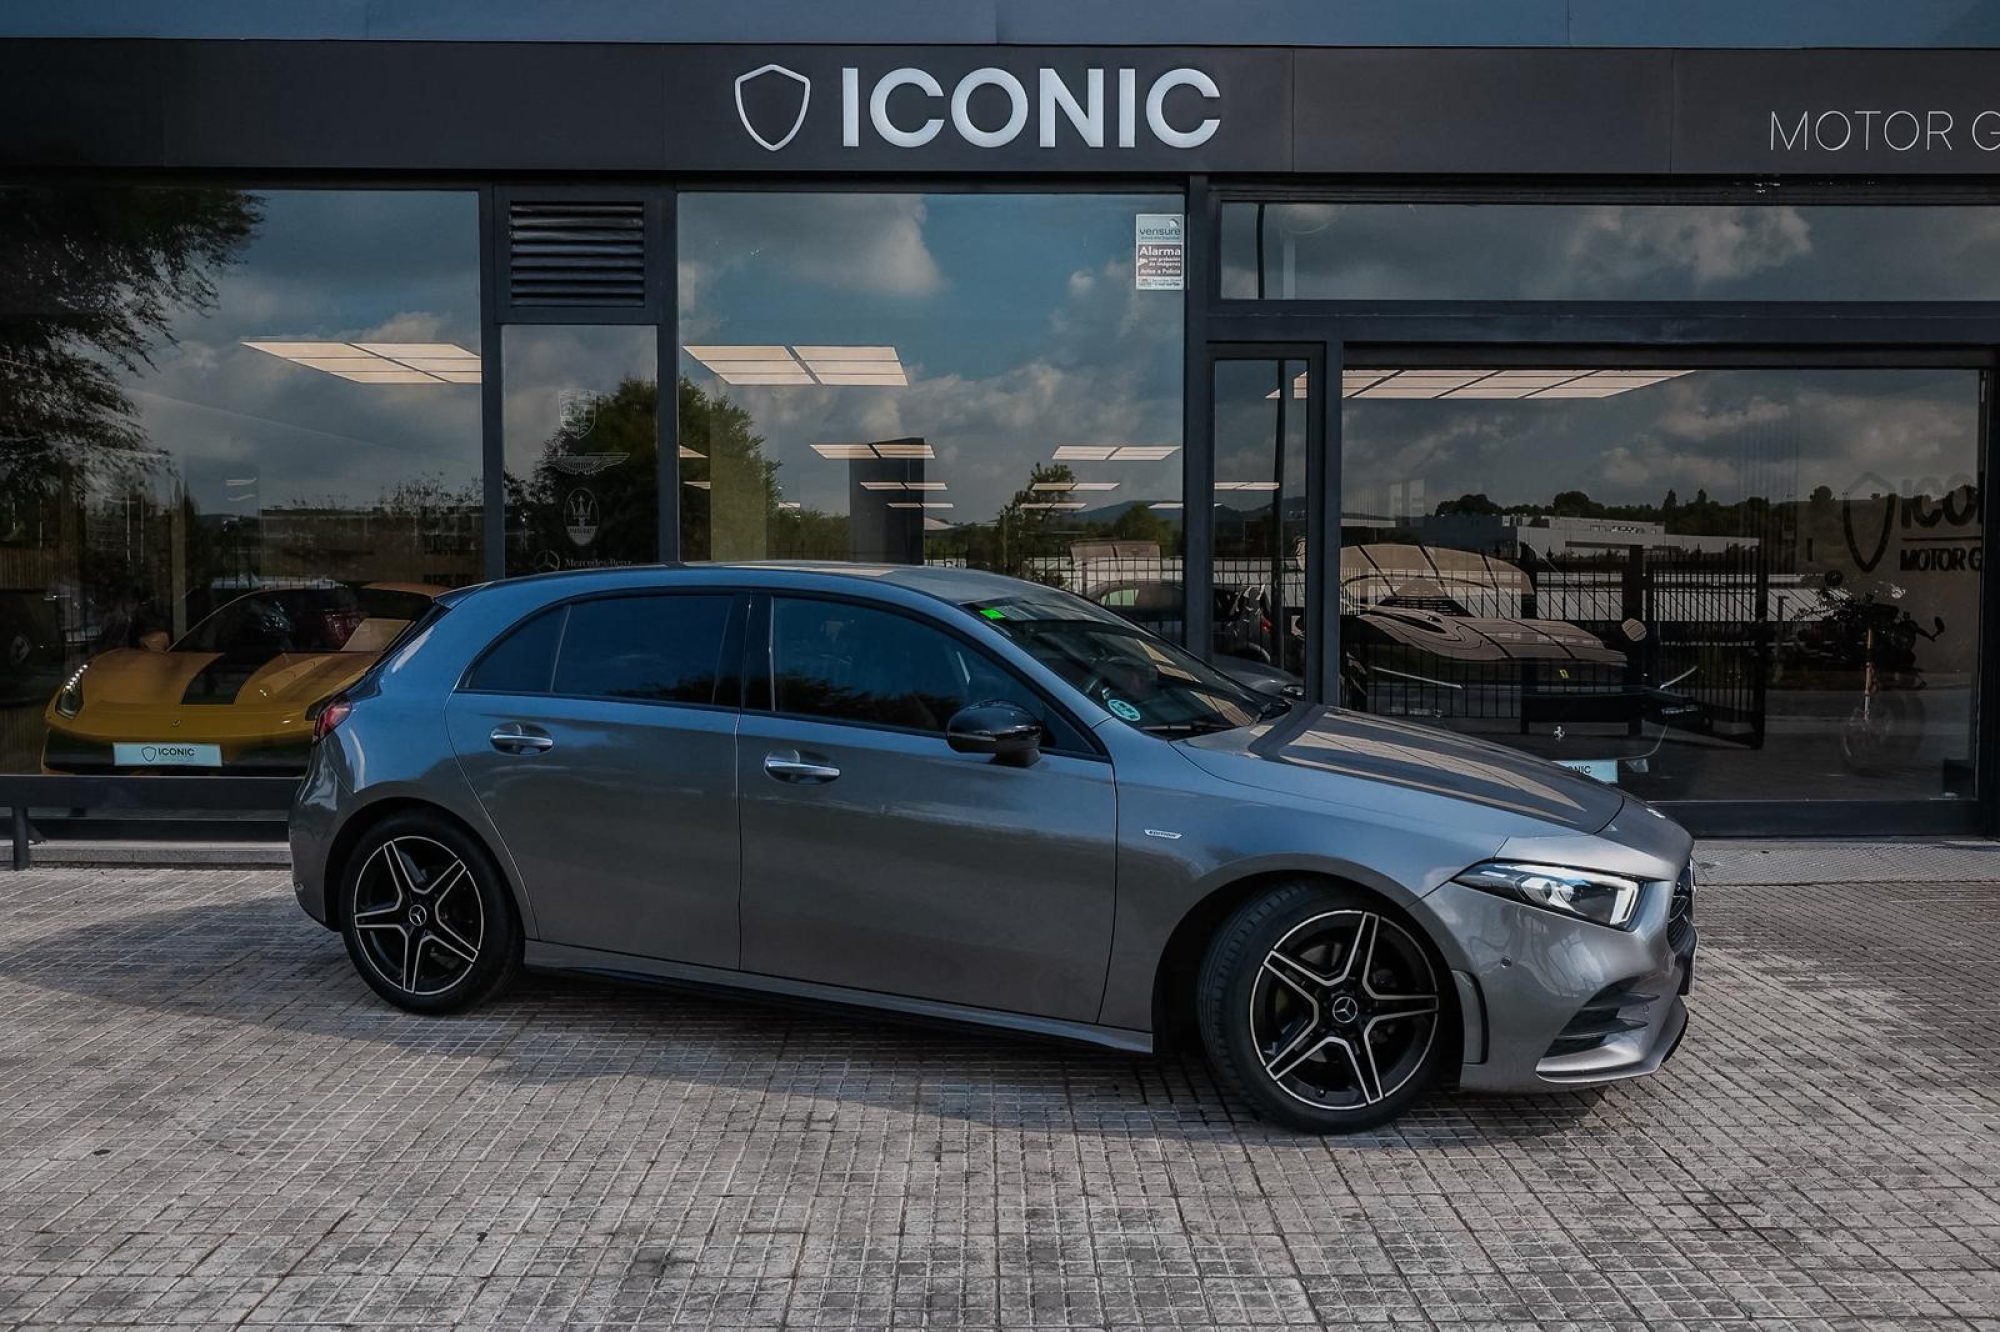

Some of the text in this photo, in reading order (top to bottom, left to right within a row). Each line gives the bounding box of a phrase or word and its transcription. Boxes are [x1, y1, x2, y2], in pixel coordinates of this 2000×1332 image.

[842, 67, 1221, 148] ICONIC
[1770, 110, 1954, 151] MOTOR
[1139, 245, 1181, 256] Alarma
[1901, 474, 1981, 528] ICO
[1900, 548, 1966, 571] MOTOR
[158, 747, 195, 757] ICONIC
